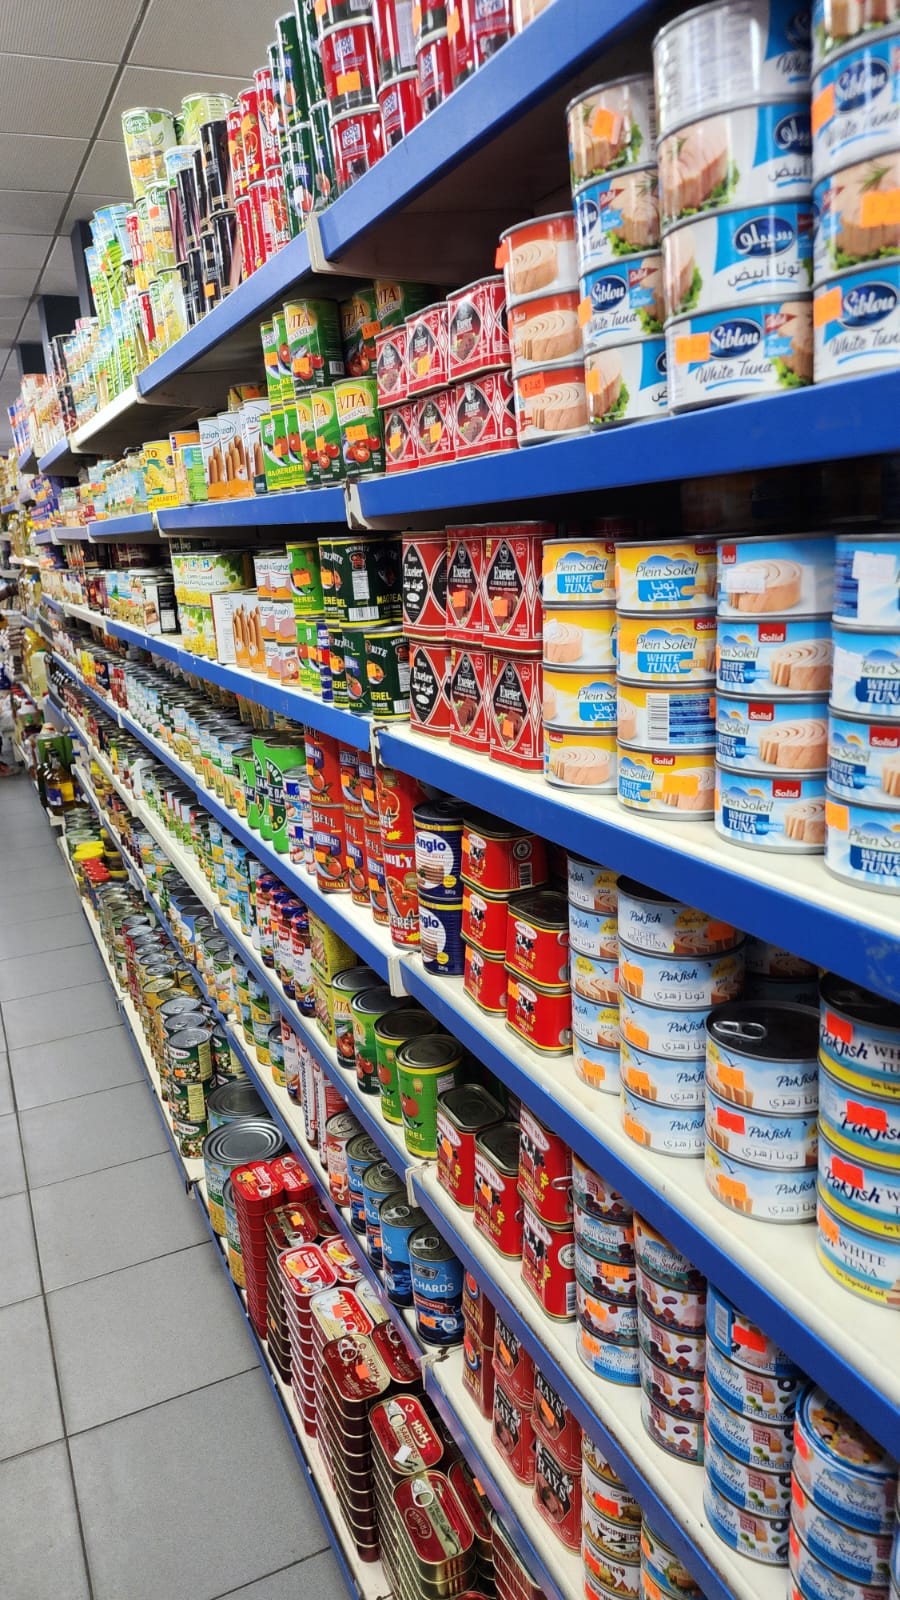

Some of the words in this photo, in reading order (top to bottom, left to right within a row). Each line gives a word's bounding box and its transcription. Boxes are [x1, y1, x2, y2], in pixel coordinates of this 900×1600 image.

[592, 284, 626, 305] Siblou
[843, 291, 895, 317] Siblou
[611, 310, 638, 327] Tuna
[710, 325, 761, 350] Siblou
[829, 337, 867, 356] White
[695, 363, 735, 385] White
[739, 358, 773, 373] Tuna
[452, 565, 472, 578] Exeter
[556, 561, 576, 572] Plein
[577, 557, 608, 572] Soleil
[636, 565, 664, 578] Plein
[666, 562, 699, 577] Soleil
[493, 566, 517, 580] Exeter
[564, 574, 594, 585] WHITE
[564, 582, 594, 593] TUNA
[636, 639, 664, 651] Plein
[664, 638, 698, 650] Soleil
[760, 633, 785, 643] Solid
[646, 653, 680, 664] WHITE
[735, 646, 760, 660] Soleil
[646, 662, 680, 674] TUNA
[722, 662, 745, 673] WHITE
[457, 673, 476, 688] Exeter
[722, 672, 745, 684] TUNA
[499, 685, 521, 701] Exeter
[577, 690, 603, 701] Plein
[750, 711, 773, 721] Solid
[725, 722, 749, 738] Soleil
[871, 737, 899, 747] Solid
[653, 757, 674, 765] Solid
[841, 748, 870, 764] Soleil
[630, 767, 655, 781] Soleil
[774, 789, 799, 799] Solid
[721, 793, 742, 807] Plein
[744, 800, 774, 813] Soleil
[727, 810, 754, 824] WHITE
[727, 820, 757, 835] TUNA
[415, 835, 447, 853] Anglo
[848, 829, 880, 848] Plein
[630, 911, 663, 924] Pakfish
[658, 968, 699, 984] Pakfish
[534, 1129, 548, 1150] BELL
[748, 1126, 792, 1141] Pakfish
[489, 1173, 503, 1191] BELL
[838, 1236, 886, 1268] WHITE
[659, 1257, 687, 1273] Salad
[843, 1255, 878, 1279] TUNA
[496, 1318, 518, 1355] RAYS
[719, 1371, 743, 1394] Salad
[536, 1375, 563, 1418] RAYS
[495, 1396, 519, 1434] RAYS
[723, 1422, 749, 1445] Salad
[400, 1426, 419, 1460] SARDINES
[538, 1457, 568, 1502] RAYS
[719, 1467, 745, 1489] Salad
[844, 1492, 881, 1513] Salad
[715, 1506, 738, 1530] Salad
[836, 1542, 872, 1563] Salad
